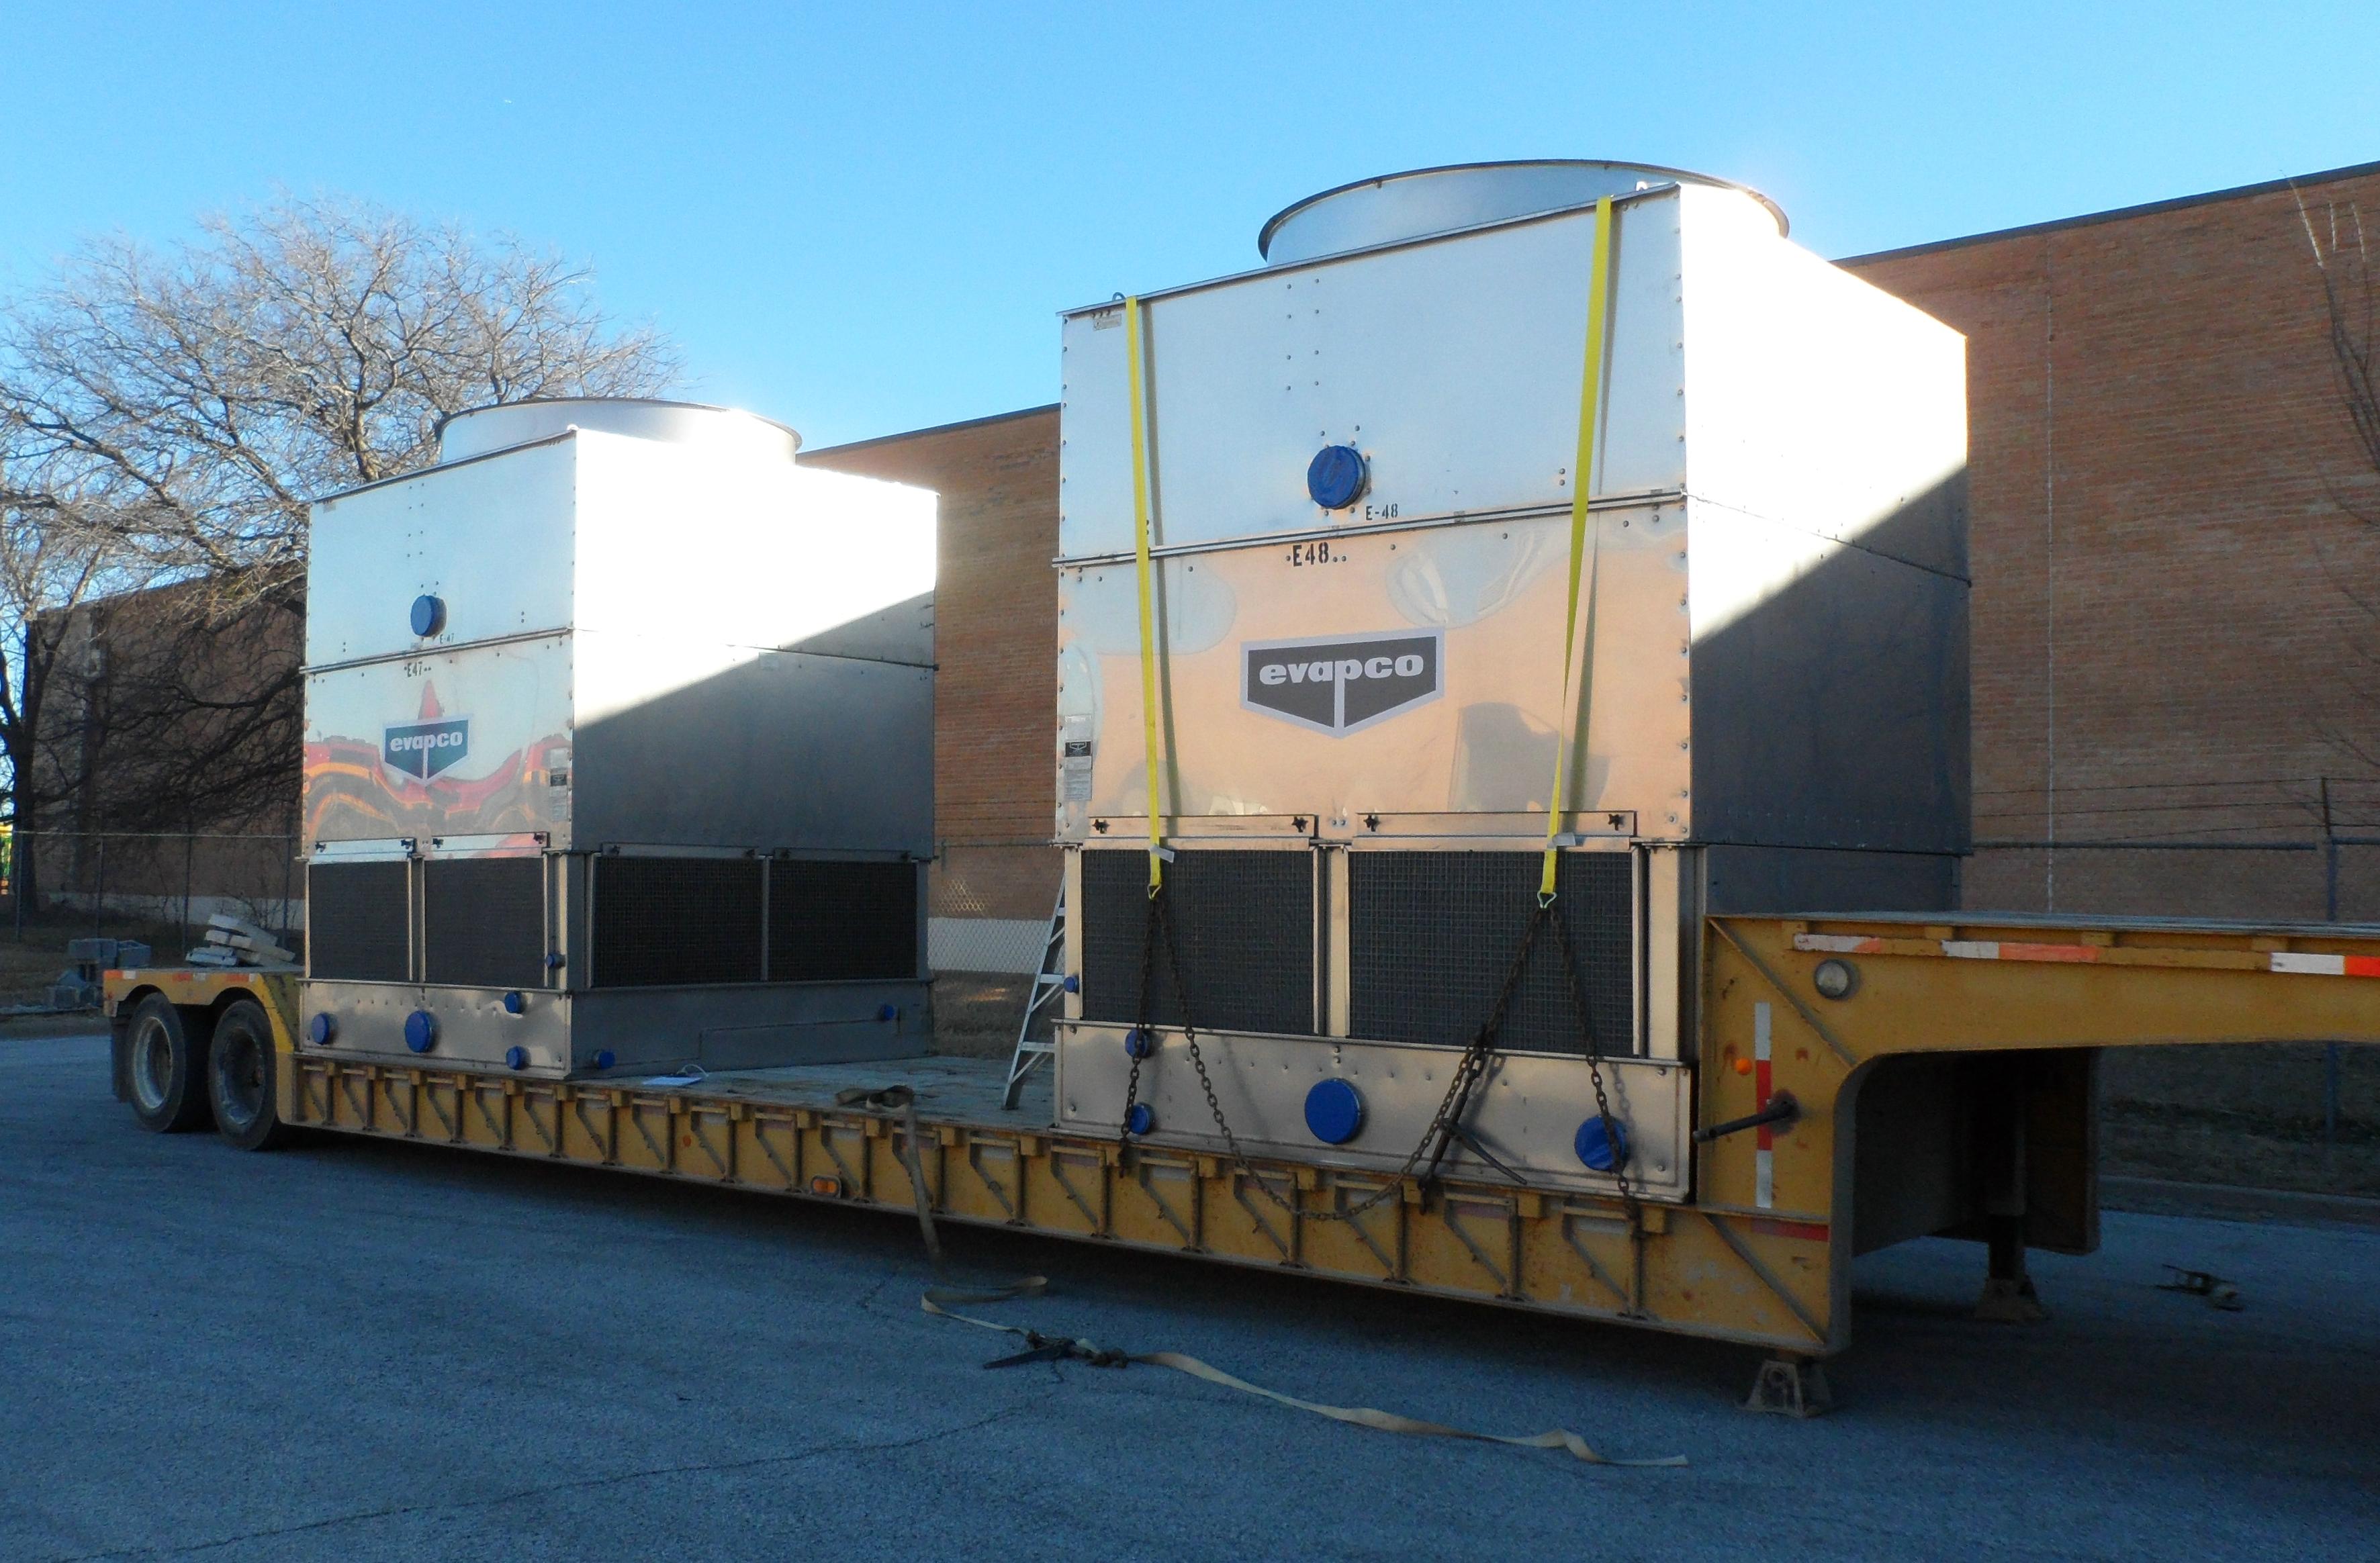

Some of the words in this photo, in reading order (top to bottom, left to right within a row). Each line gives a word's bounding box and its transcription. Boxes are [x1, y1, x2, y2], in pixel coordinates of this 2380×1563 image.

[1365, 504, 1398, 521] E-48
[1259, 655, 1424, 685] evapco
[390, 731, 463, 752] evapco
